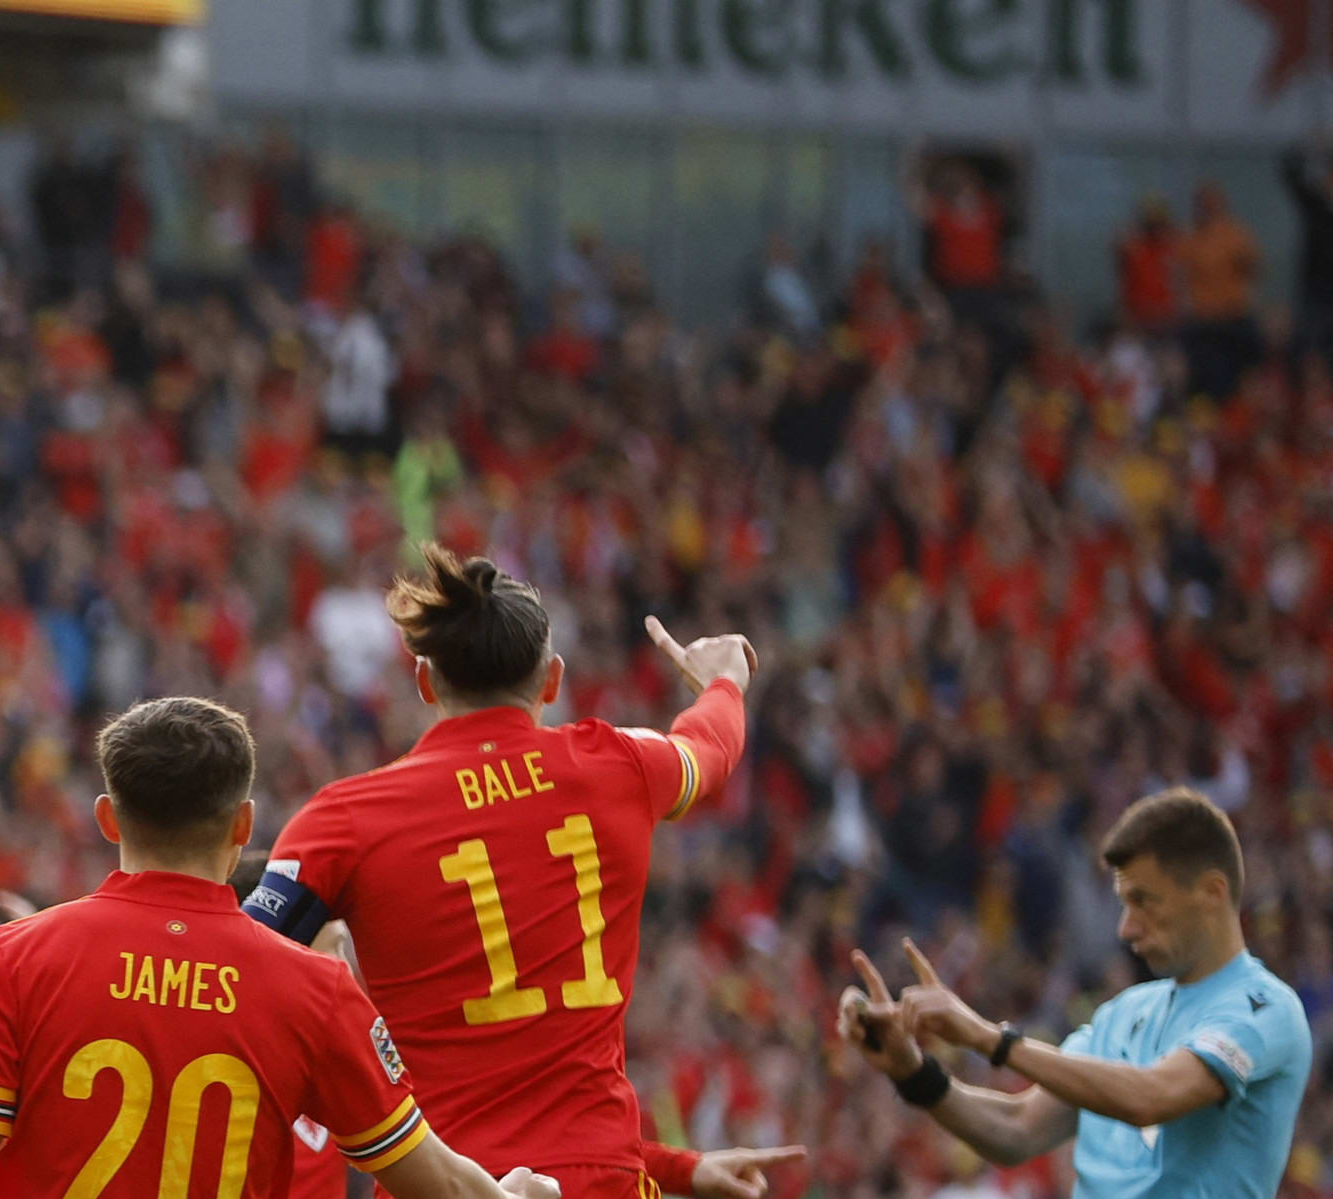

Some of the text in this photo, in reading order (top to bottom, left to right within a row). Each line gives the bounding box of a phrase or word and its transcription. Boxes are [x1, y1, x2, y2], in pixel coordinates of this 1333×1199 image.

[455, 751, 555, 810] BALE
[439, 813, 624, 1025] 11
[109, 952, 240, 1014] JAMES
